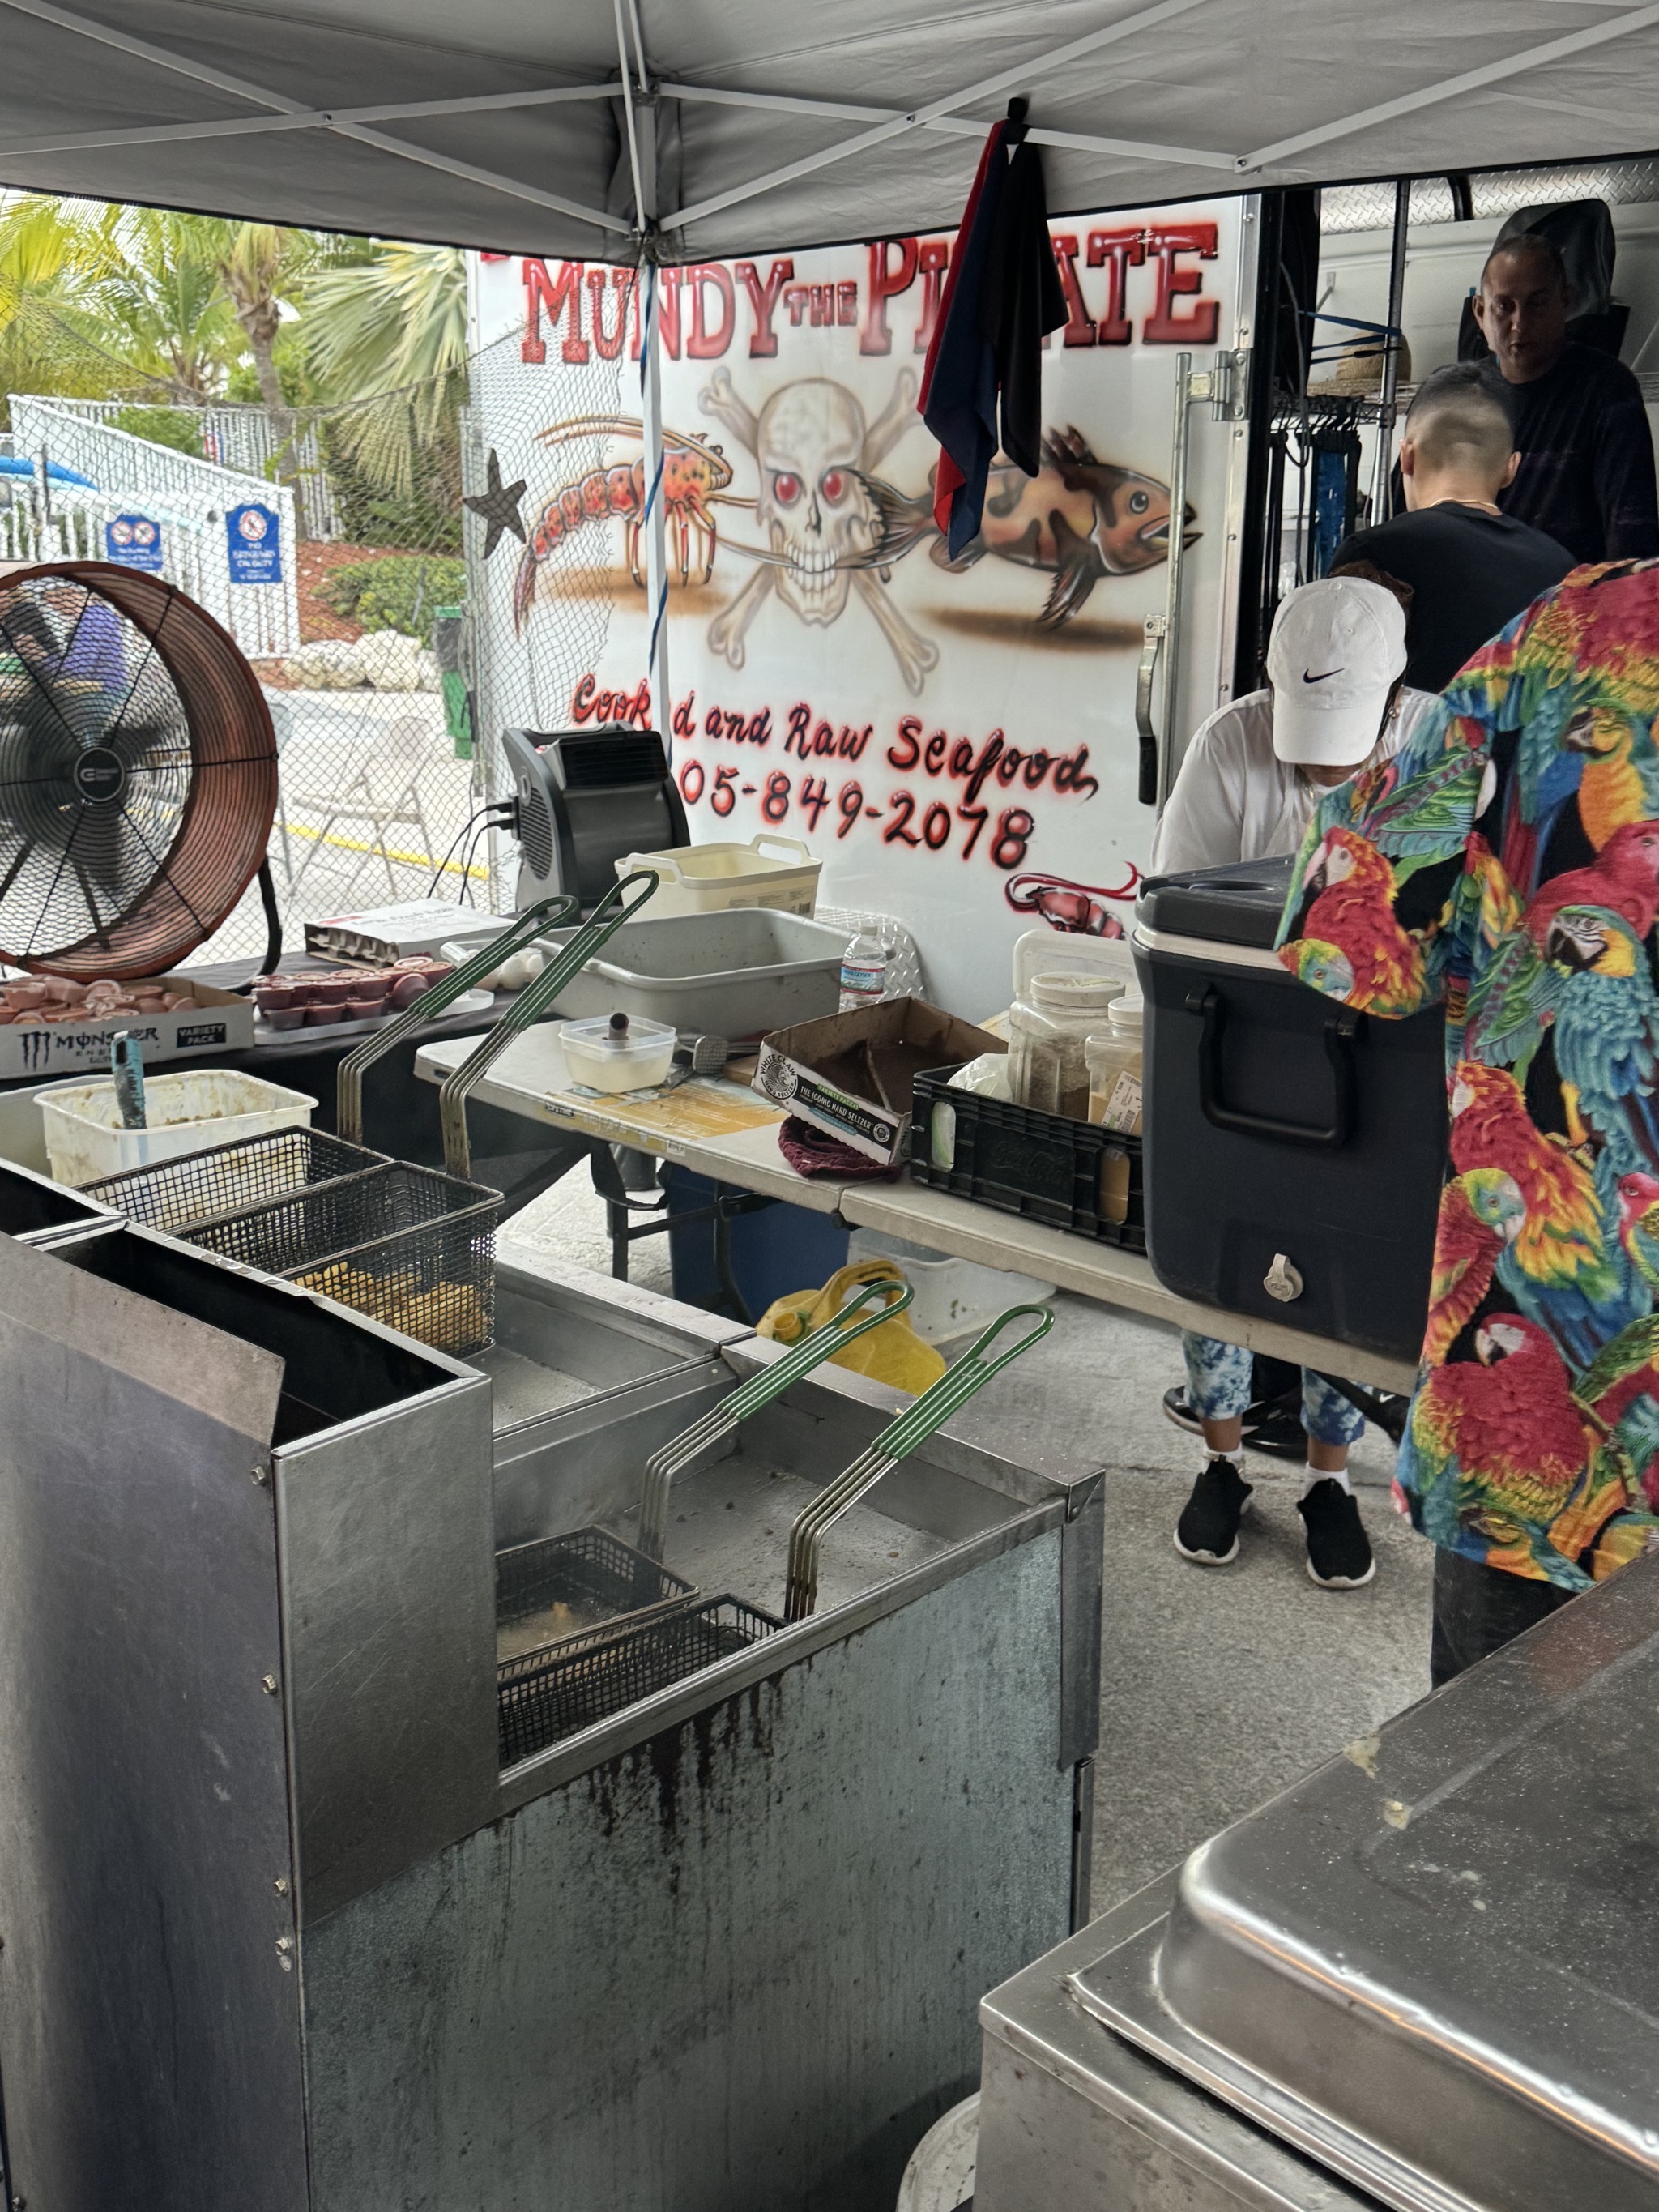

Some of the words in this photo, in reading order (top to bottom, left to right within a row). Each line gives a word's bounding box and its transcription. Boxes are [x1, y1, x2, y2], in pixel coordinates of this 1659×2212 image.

[522, 258, 795, 365] MUNDY
[783, 280, 858, 327] THE
[859, 224, 1221, 357] PIATE
[573, 673, 697, 739] Cookd
[705, 704, 773, 746] and
[783, 702, 874, 762] Raw
[886, 716, 1099, 805] Seafood
[680, 758, 1035, 870] 05-849-2078
[56, 1027, 160, 1050] MONSER
[187, 1035, 215, 1044] PACK
[760, 1053, 777, 1074] WHITE
[778, 1055, 796, 1076] CLAW
[800, 1086, 811, 1097] THE
[811, 1091, 831, 1108] ICONIC
[831, 1103, 847, 1116] HARD
[847, 1111, 872, 1129] SELTZER
